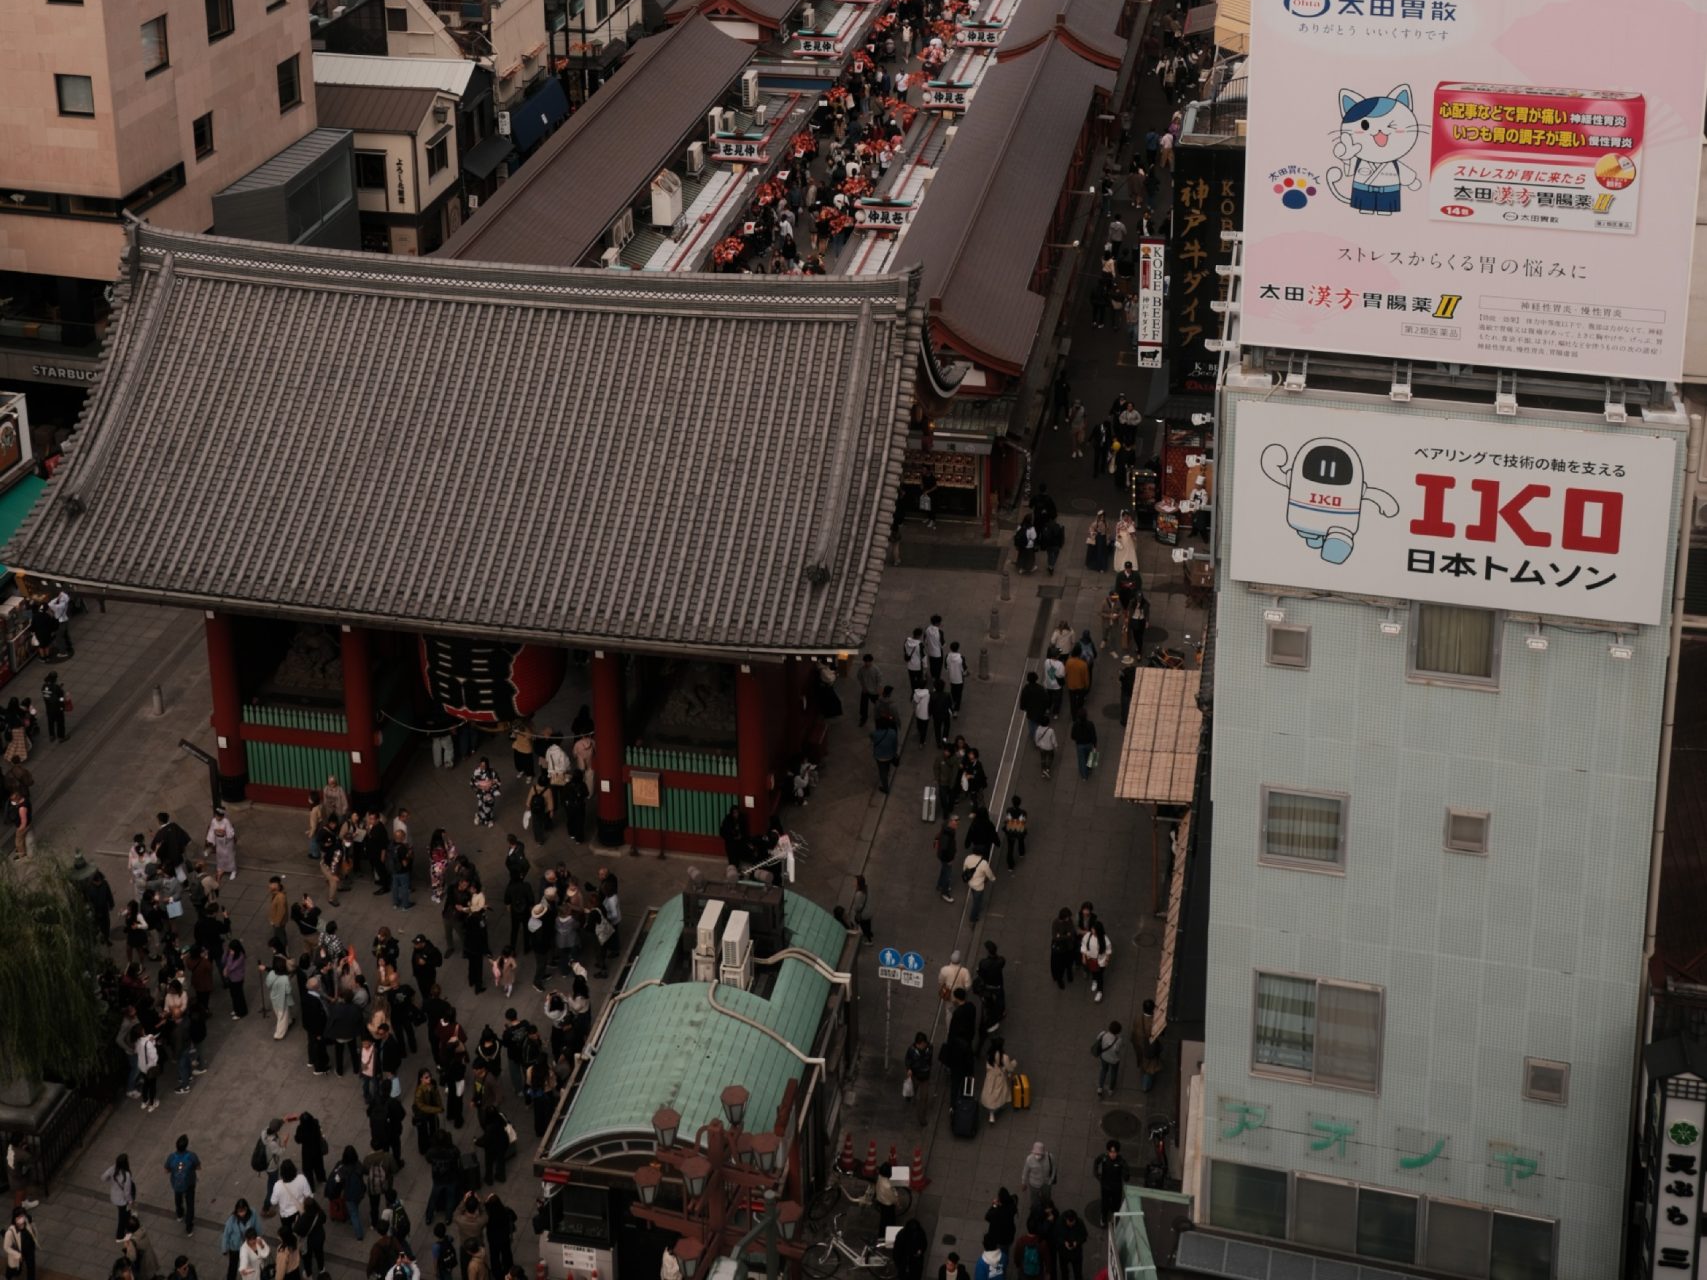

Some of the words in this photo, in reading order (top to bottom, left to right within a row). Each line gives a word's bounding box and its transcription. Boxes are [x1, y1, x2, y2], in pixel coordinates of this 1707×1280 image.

[1299, 23, 1356, 37] ありがとう
[1365, 28, 1449, 41] いいくすりです
[1439, 102, 1568, 125] 心配事などで胃が痛い
[1570, 113, 1627, 127] 神経性胃炎
[1453, 126, 1586, 148] いつも胃の調子が悪い
[1588, 136, 1633, 149] 慢性胃炎
[1268, 165, 1321, 185] 太田胃にゃん
[1152, 246, 1163, 292] KOBE
[1179, 181, 1209, 347] 神戸牛ダイア
[1337, 247, 1587, 280] ストレスからくる胃の悩みに
[1152, 296, 1162, 341] BEEF
[1404, 325, 1459, 338] 第2類医薬品
[1414, 447, 1626, 479] ベアリングで技術の軸を支える
[1309, 492, 1342, 507] IKO
[1409, 473, 1624, 555] IKO
[1407, 548, 1617, 591] 日本トムソン
